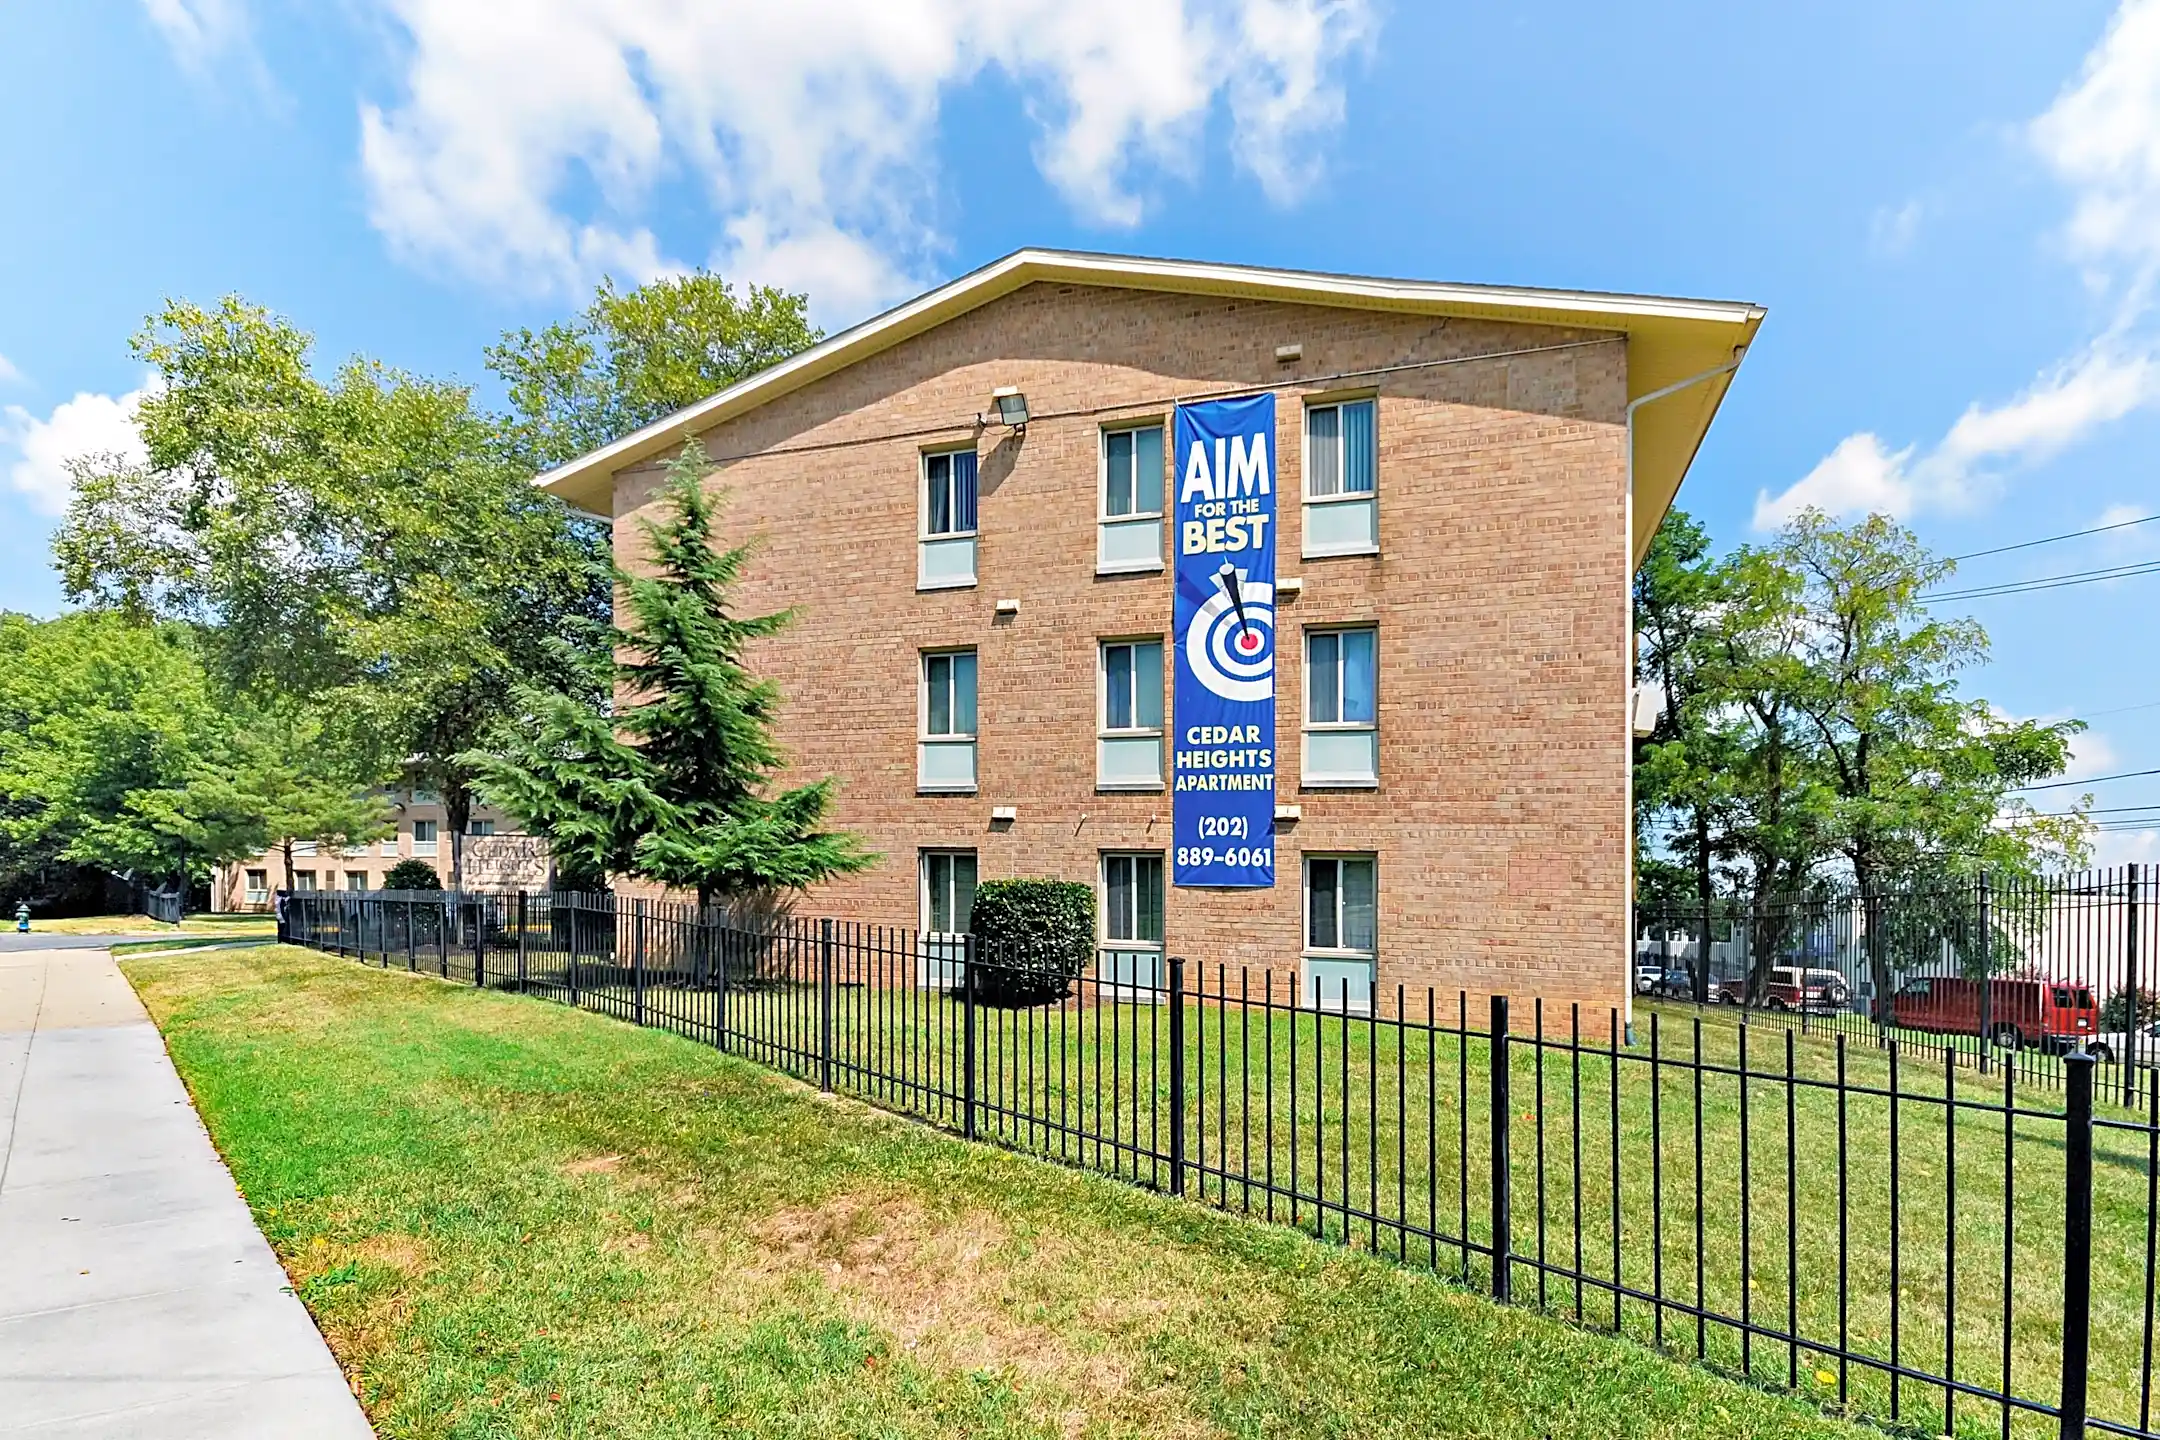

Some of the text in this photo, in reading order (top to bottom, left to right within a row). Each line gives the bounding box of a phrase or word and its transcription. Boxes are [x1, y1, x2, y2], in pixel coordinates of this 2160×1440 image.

[1180, 432, 1270, 503] AIM
[1194, 499, 1259, 518] FOR THE
[1182, 514, 1269, 555] BEST
[1186, 725, 1261, 745] CEDAR
[1176, 749, 1272, 769] HEIGHTS
[1175, 774, 1274, 792] APARTMENT
[1198, 816, 1248, 840] (202)
[473, 840, 541, 858] CEDAR
[1177, 847, 1271, 867] 889-6061
[467, 859, 545, 876] HEIGHTS
